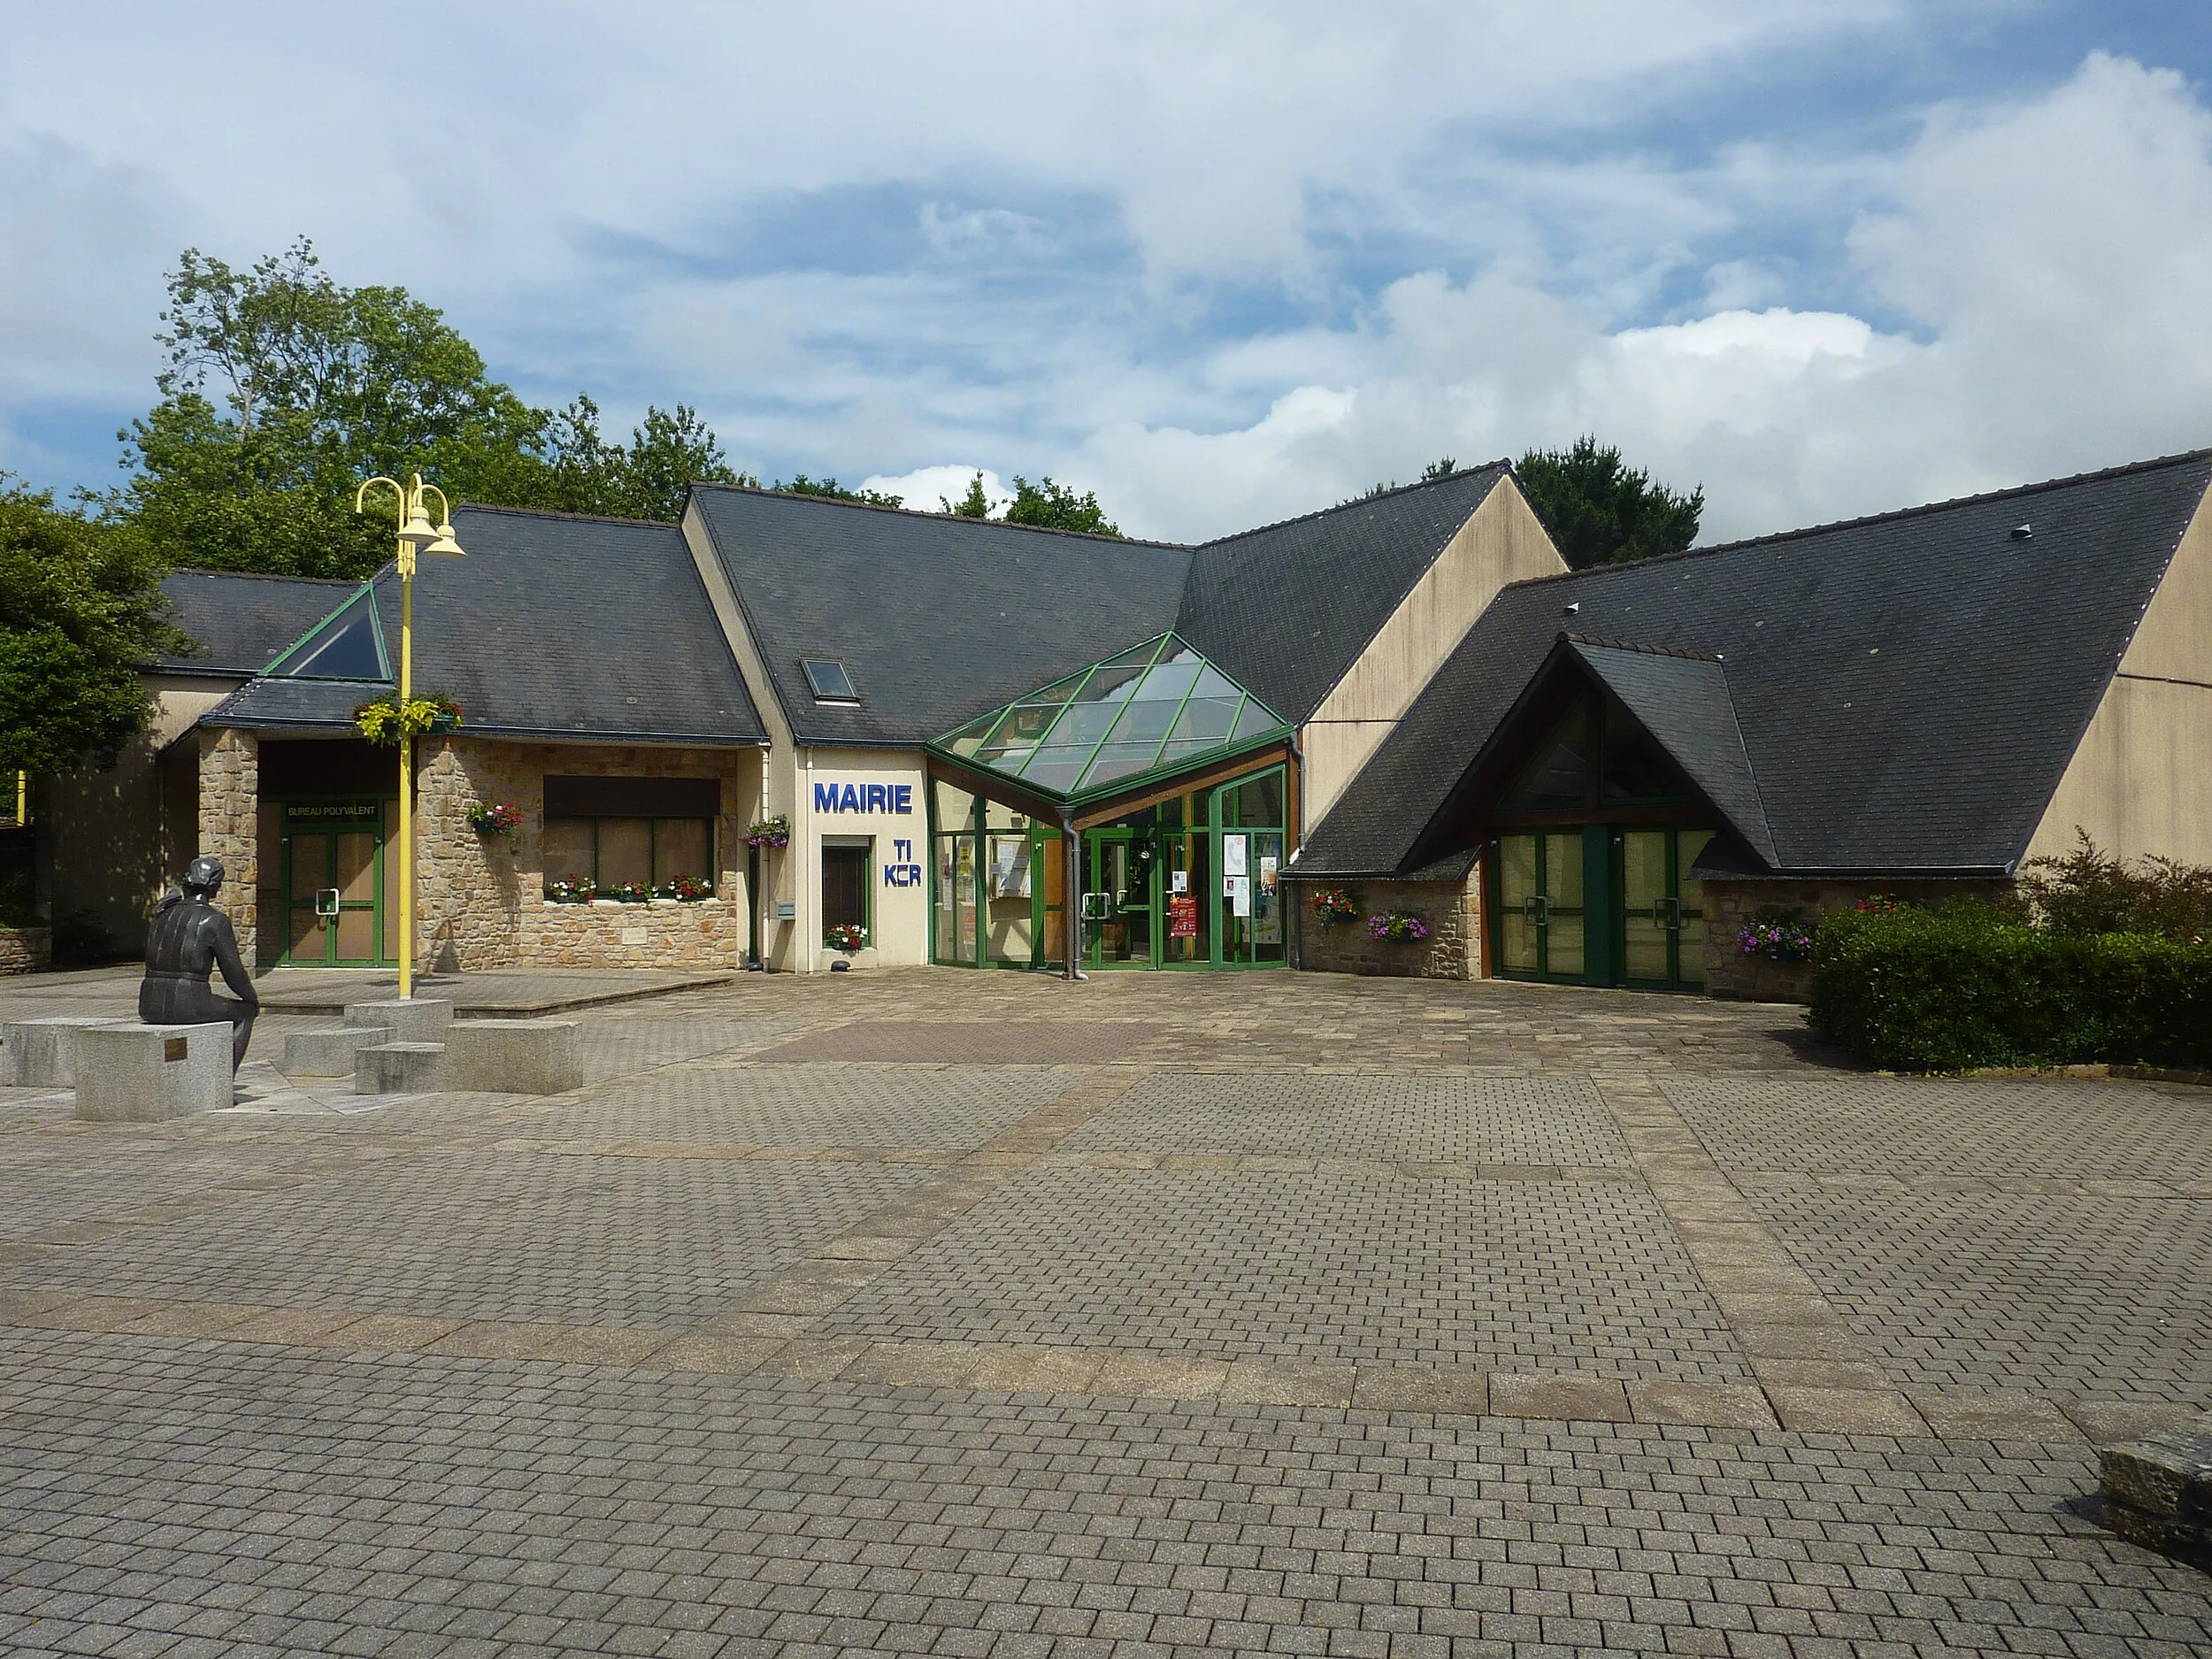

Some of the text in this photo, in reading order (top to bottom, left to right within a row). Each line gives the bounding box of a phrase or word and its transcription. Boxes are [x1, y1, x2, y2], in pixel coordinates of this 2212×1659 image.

[814, 783, 912, 813] MAIRIE
[324, 806, 376, 815] POLYVALENT
[894, 840, 911, 861] TI
